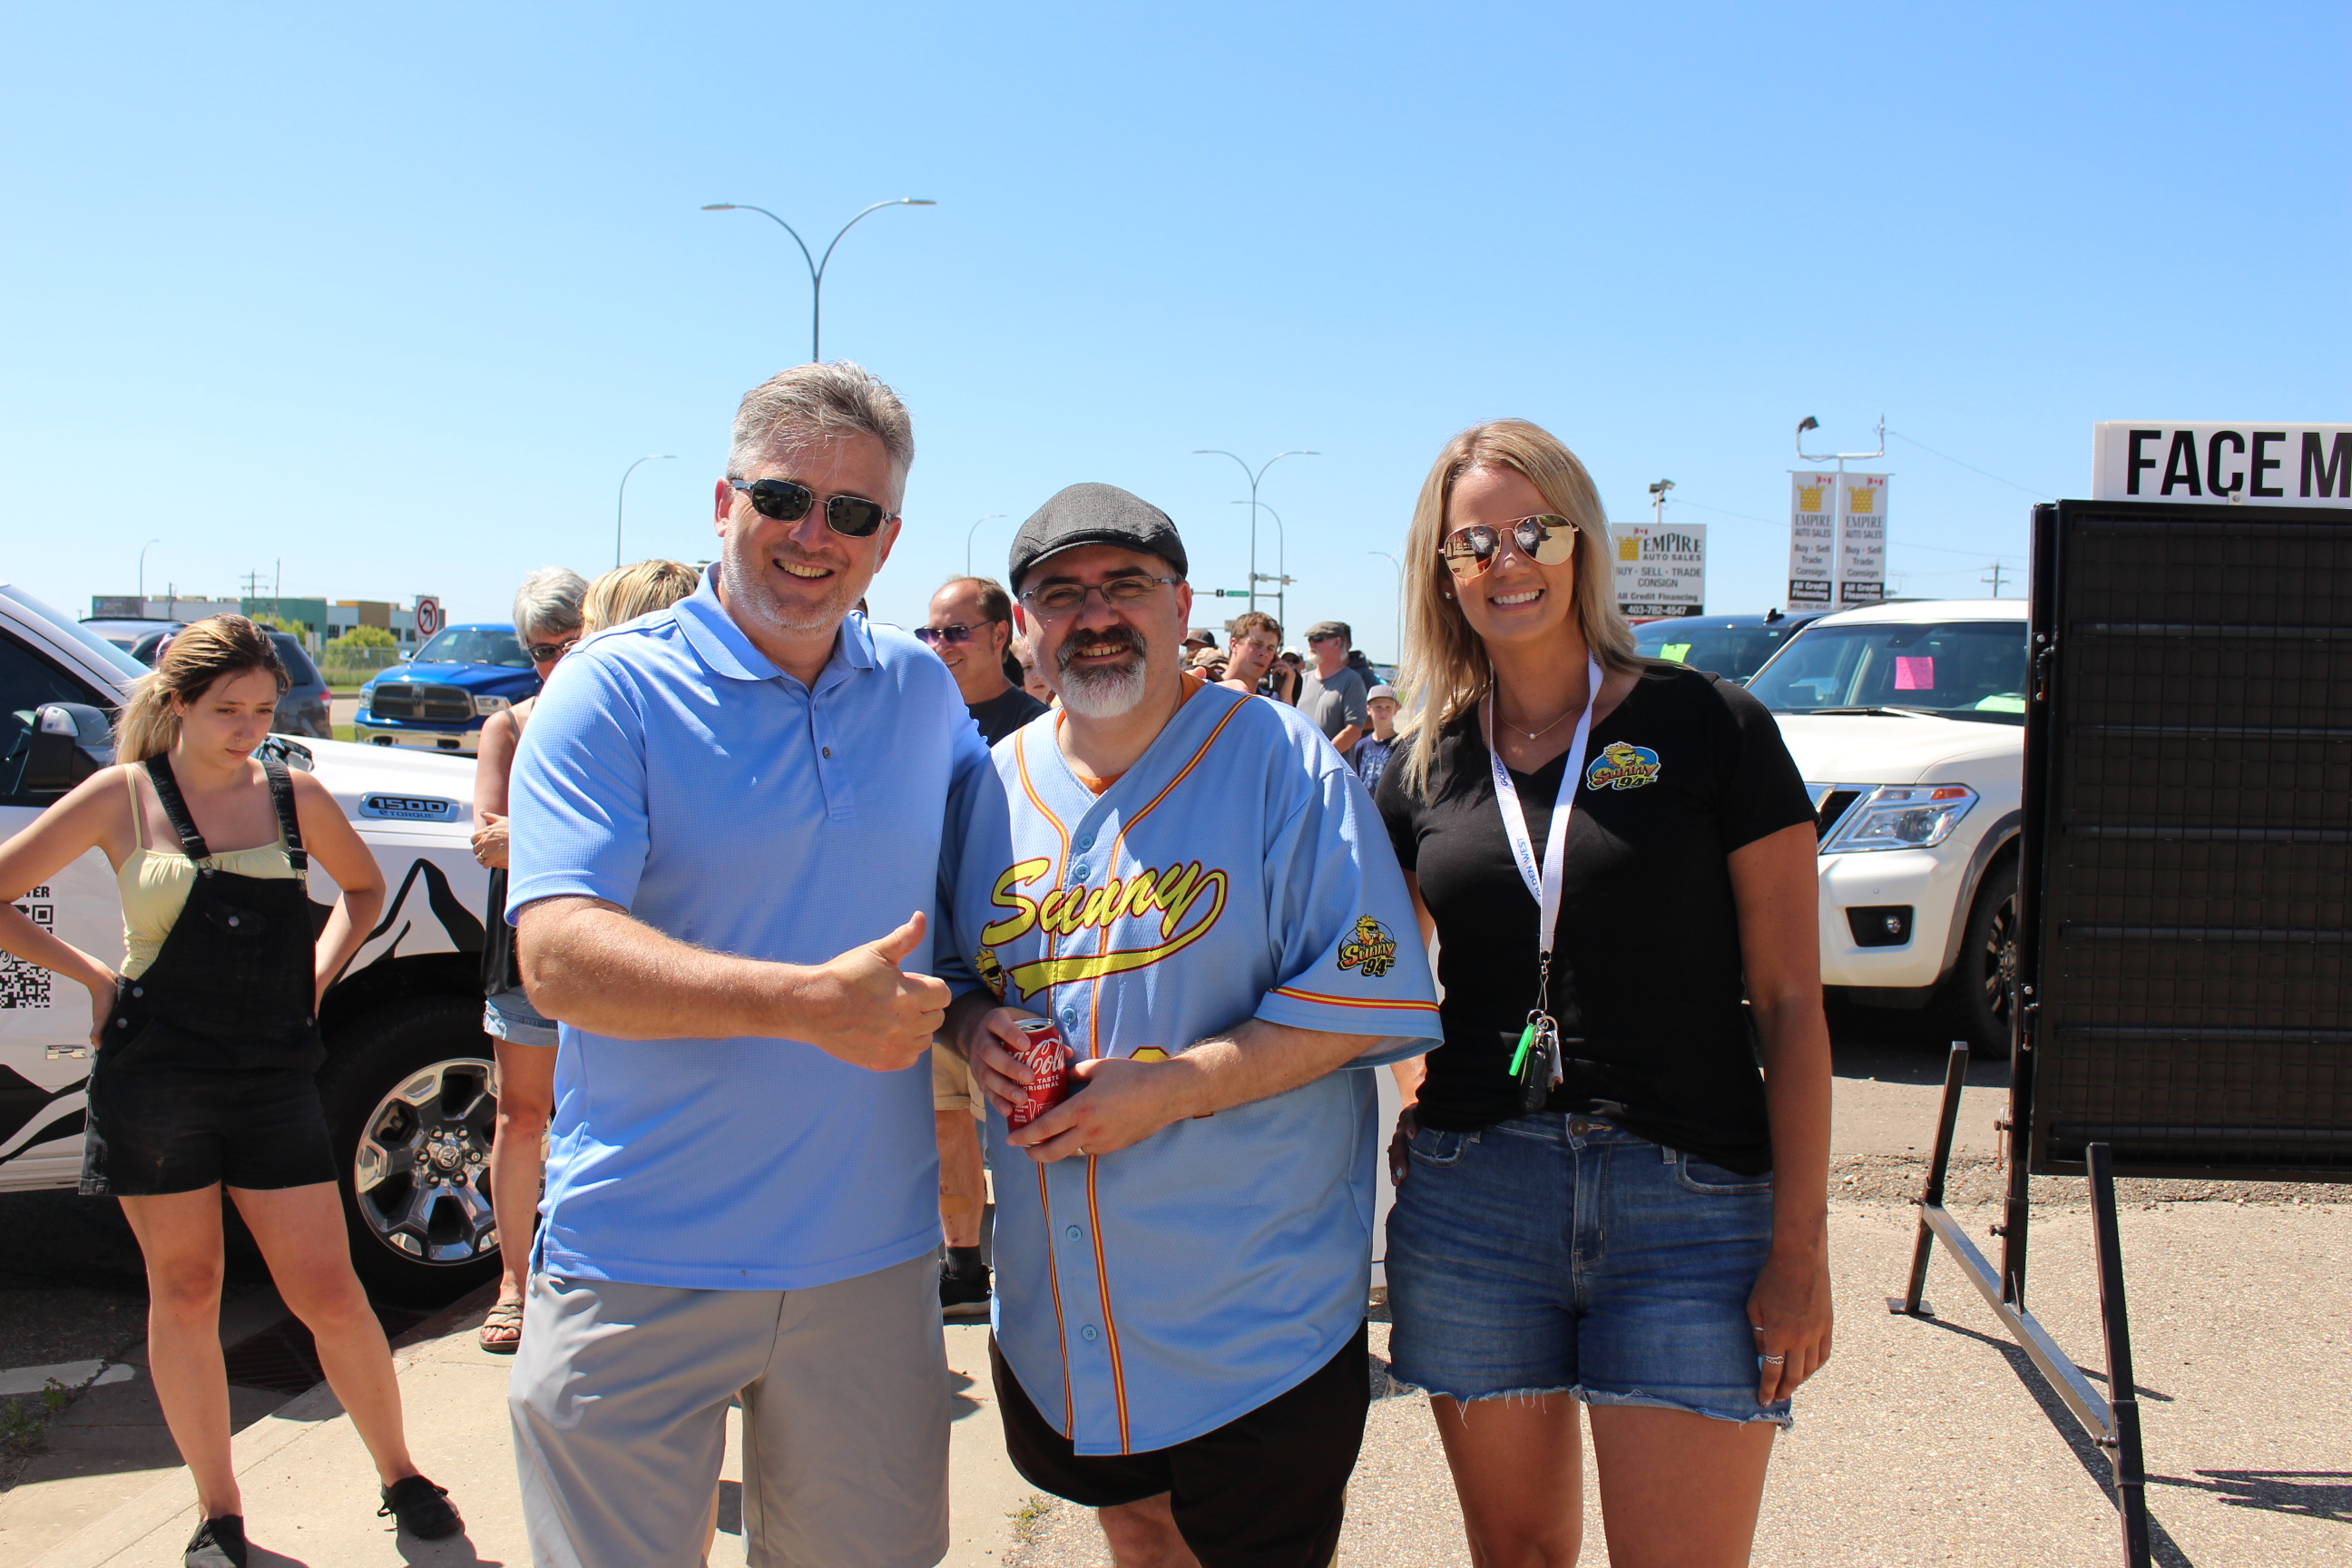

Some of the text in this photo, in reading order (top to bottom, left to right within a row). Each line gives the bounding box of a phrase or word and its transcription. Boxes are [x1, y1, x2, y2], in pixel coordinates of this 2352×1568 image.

[2126, 429, 2287, 497] FACE
[1796, 514, 1831, 526] EMPIRE
[1846, 515, 1883, 528] EMPIRE
[1795, 528, 1831, 538] AUTO SALES
[1846, 530, 1883, 539] AUTO SALES
[1643, 533, 1702, 553] EMPIRE
[1795, 544, 1830, 554] Buy Sell
[1846, 545, 1882, 555] Buy Sell
[1671, 554, 1701, 562] SALES
[1801, 555, 1822, 564] Trade
[1853, 557, 1874, 566] Trade
[1616, 566, 1702, 577] BUY SELL TRADE
[1796, 567, 1827, 576] Consign
[1847, 568, 1878, 578] Consign
[1638, 578, 1678, 587] CONSIGN
[1793, 582, 1828, 591] All Credit
[1845, 583, 1881, 593] All Credit
[1658, 593, 1698, 603] Financing
[1792, 590, 1828, 601] Financing
[1628, 605, 1688, 615] 403-782-4547
[1592, 764, 1658, 786] Sunny
[1618, 776, 1643, 789] 94
[374, 798, 446, 812] 1500
[1516, 838, 1532, 863] WEST
[980, 857, 1229, 964] Sunny
[1342, 942, 1396, 968] Sunny
[1364, 956, 1387, 975] 94
[1037, 1074, 1059, 1084] TASTE
[1023, 1081, 1059, 1091] ORIGINAL
